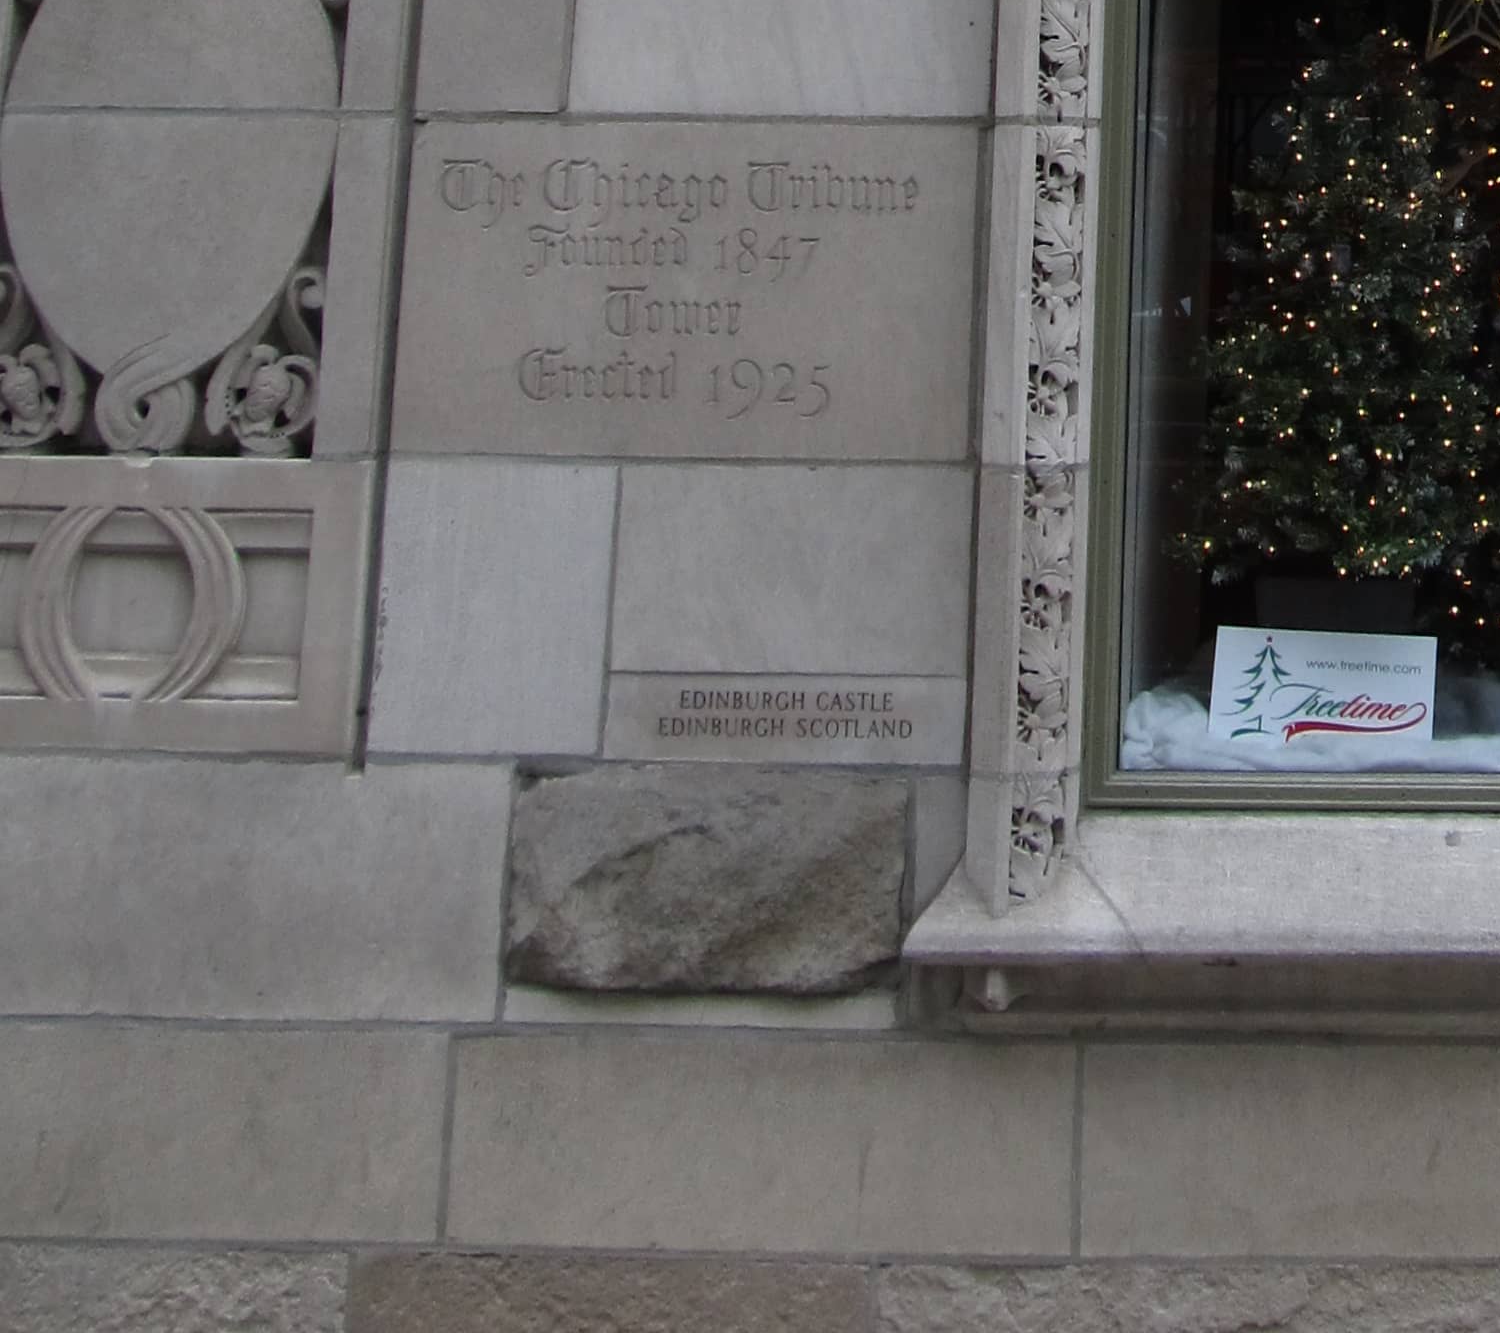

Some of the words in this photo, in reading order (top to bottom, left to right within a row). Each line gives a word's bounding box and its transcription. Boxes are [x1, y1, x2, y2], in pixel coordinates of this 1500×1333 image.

[438, 157, 524, 230] The
[542, 157, 728, 227] Chicago
[746, 160, 919, 213] Tribune
[522, 223, 689, 278] Founded
[712, 227, 821, 283] 1847
[603, 284, 743, 338] Tower
[517, 347, 678, 402] Erected
[707, 358, 832, 419] 1925
[1306, 658, 1423, 676] www.treetime.com
[679, 689, 806, 712] EDINBURGH
[815, 691, 895, 713] CASTLE
[1270, 683, 1428, 725] Treetime
[658, 716, 785, 738] EDINBURGH
[796, 717, 914, 740] SCOTLAND
